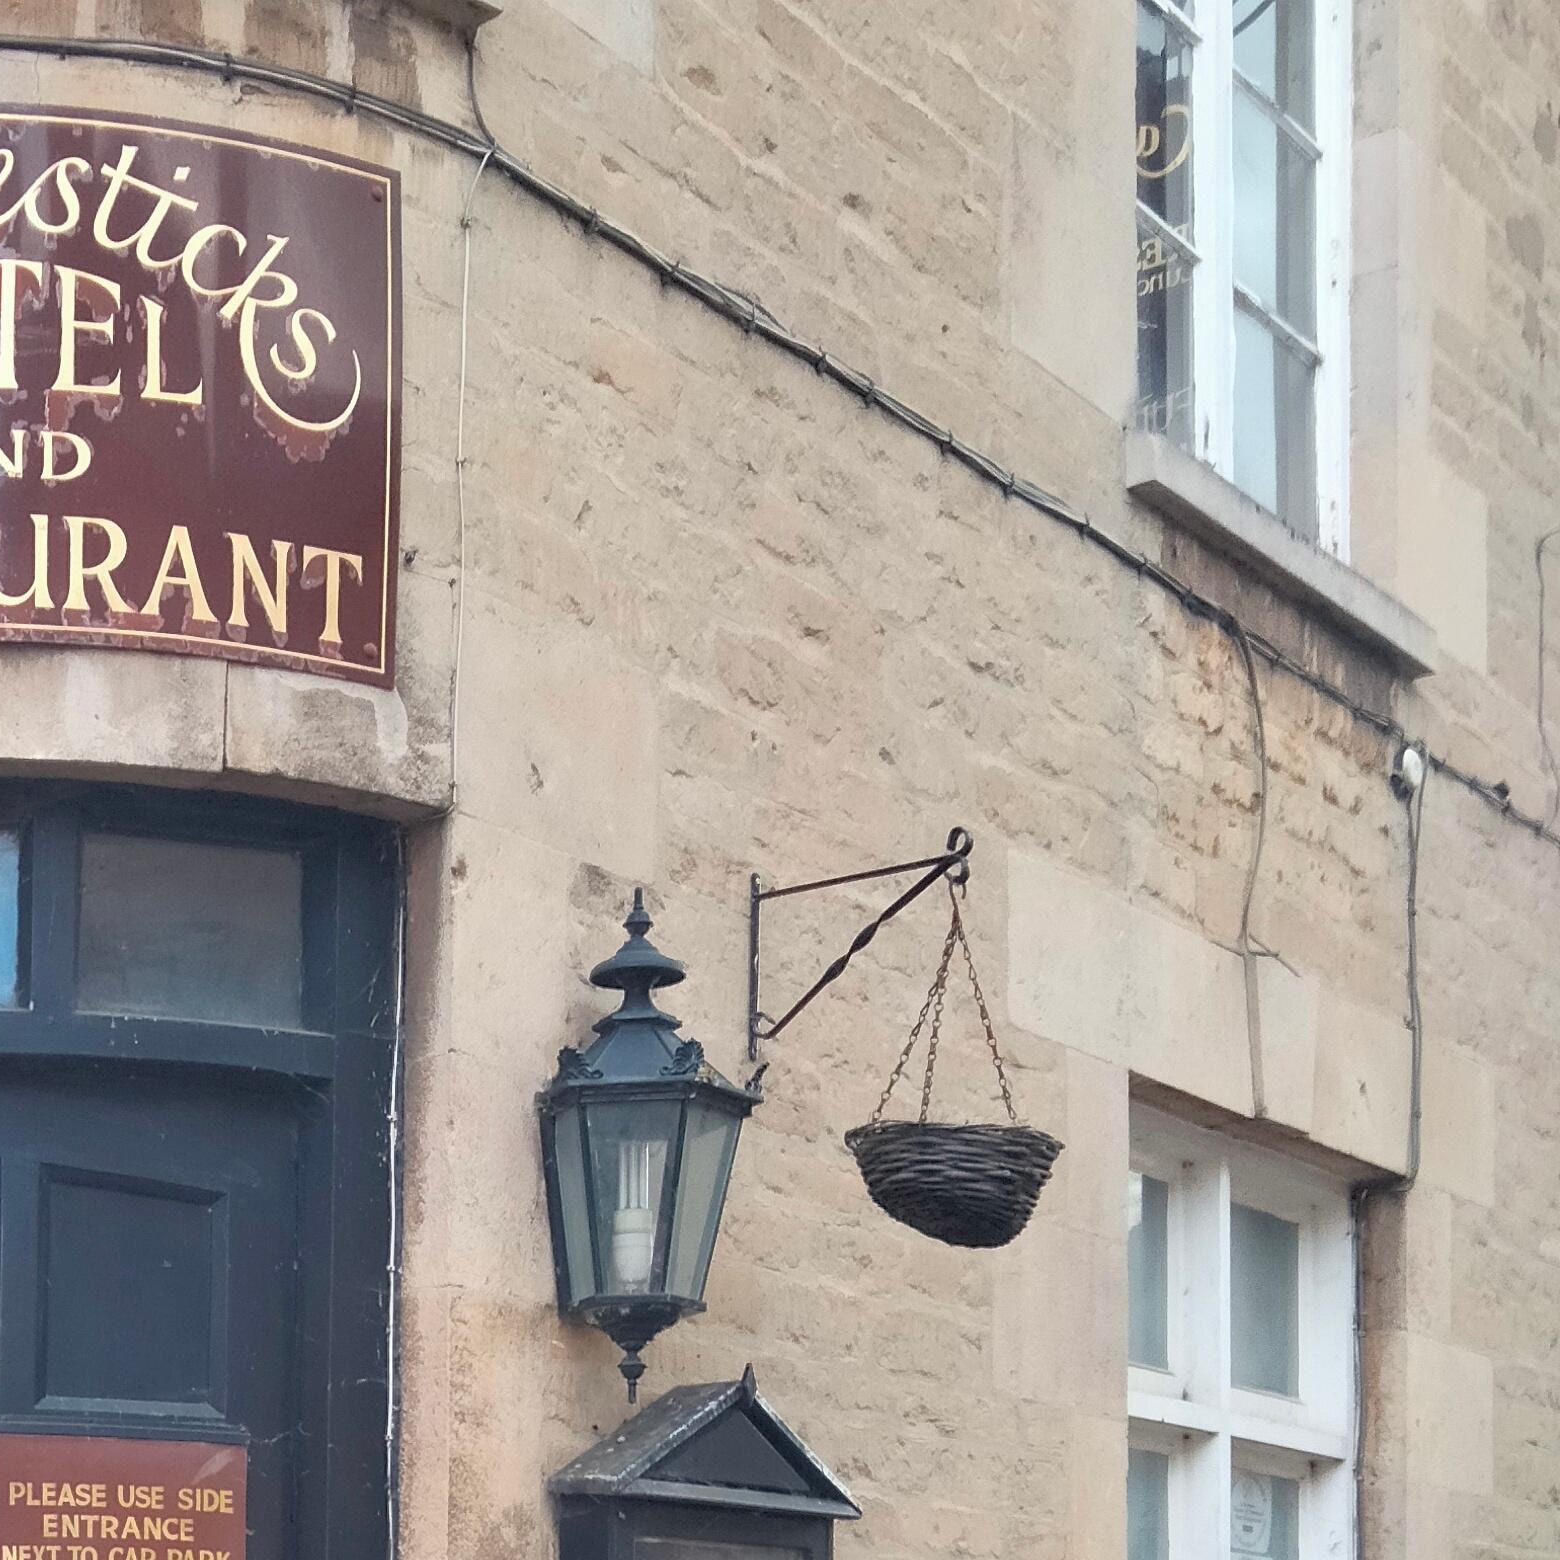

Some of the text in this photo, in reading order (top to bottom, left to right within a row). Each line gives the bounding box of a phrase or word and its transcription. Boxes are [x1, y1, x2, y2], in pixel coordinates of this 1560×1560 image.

[9, 1482, 235, 1514] PLEASE USE SIDE
[43, 1514, 195, 1542] ENTRANCE
